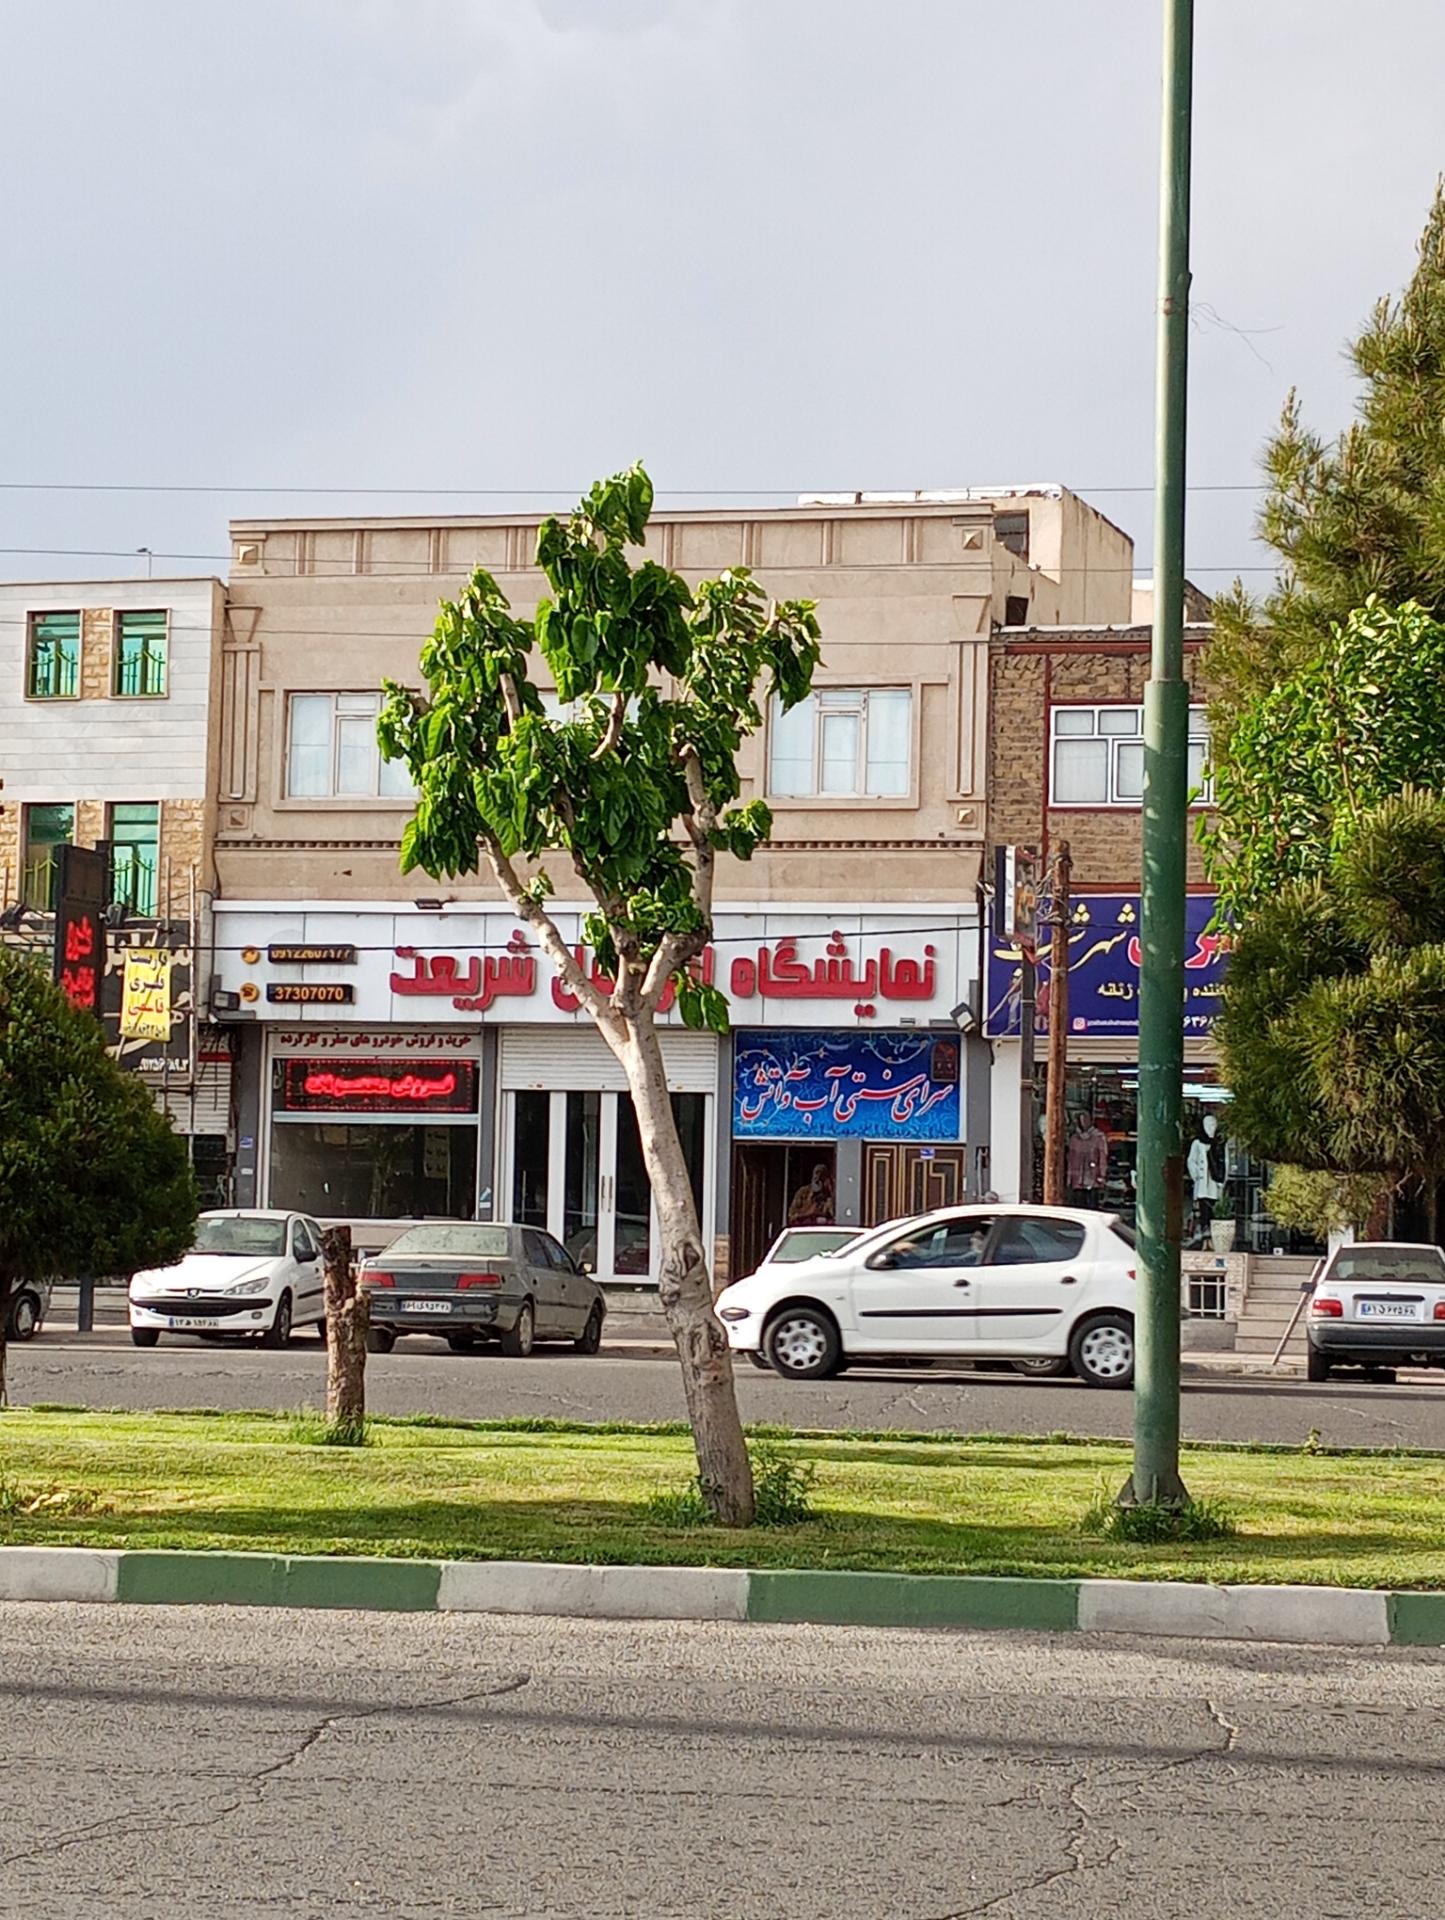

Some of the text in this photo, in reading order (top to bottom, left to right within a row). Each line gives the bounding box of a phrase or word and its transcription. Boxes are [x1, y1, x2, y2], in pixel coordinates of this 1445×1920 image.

[274, 986, 344, 1001] 37307070
[389, 929, 537, 1011] شریعت
[730, 930, 936, 1018] نمایشگاه
[406, 1033, 435, 1049] فروش
[445, 1034, 472, 1048] خرید
[792, 1064, 852, 1126] آب
[833, 1069, 927, 1122] سنتی
[891, 1080, 954, 1122] سرای
